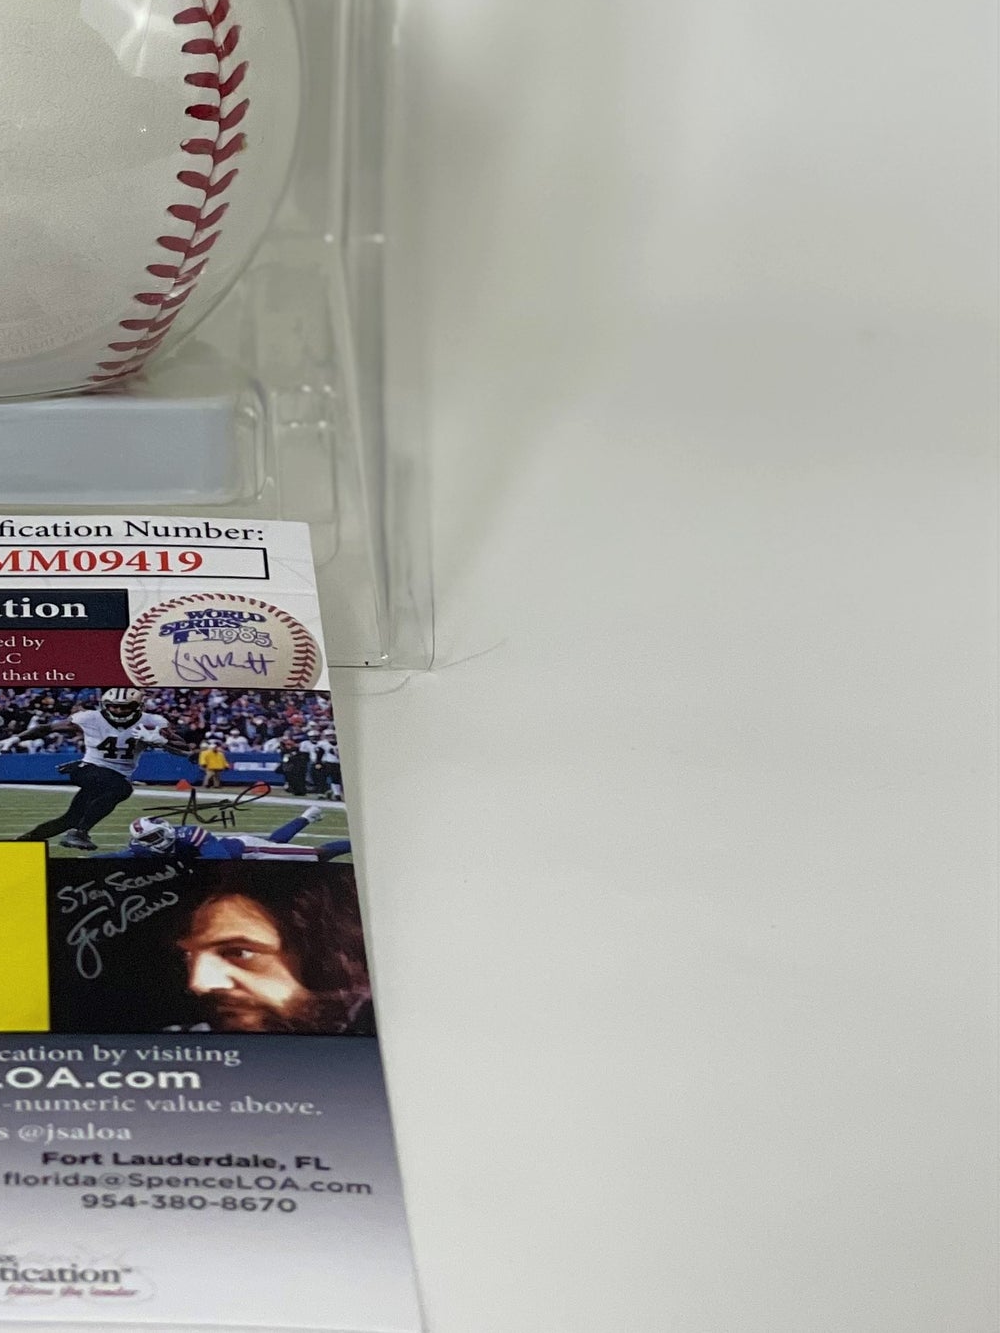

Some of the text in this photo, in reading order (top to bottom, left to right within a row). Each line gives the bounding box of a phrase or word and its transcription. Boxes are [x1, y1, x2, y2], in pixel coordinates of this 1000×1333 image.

[123, 520, 265, 541] Number:
[184, 608, 268, 623] WORLD
[158, 619, 244, 637] SERIES
[209, 626, 273, 648] 1985
[22, 635, 45, 651] by
[2, 669, 39, 681] that
[45, 669, 75, 681] the
[95, 736, 138, 760] 41
[92, 1044, 127, 1065] by
[135, 1044, 242, 1067] visiting
[145, 1093, 221, 1113] value
[230, 1094, 322, 1116] above.
[17, 1121, 131, 1146] @jsaloa
[42, 1150, 331, 1172] Fort Lauderdale, FL
[3, 1170, 373, 1196] florida@SpenceLOA.com
[81, 1192, 297, 1214] 954-380-8670
